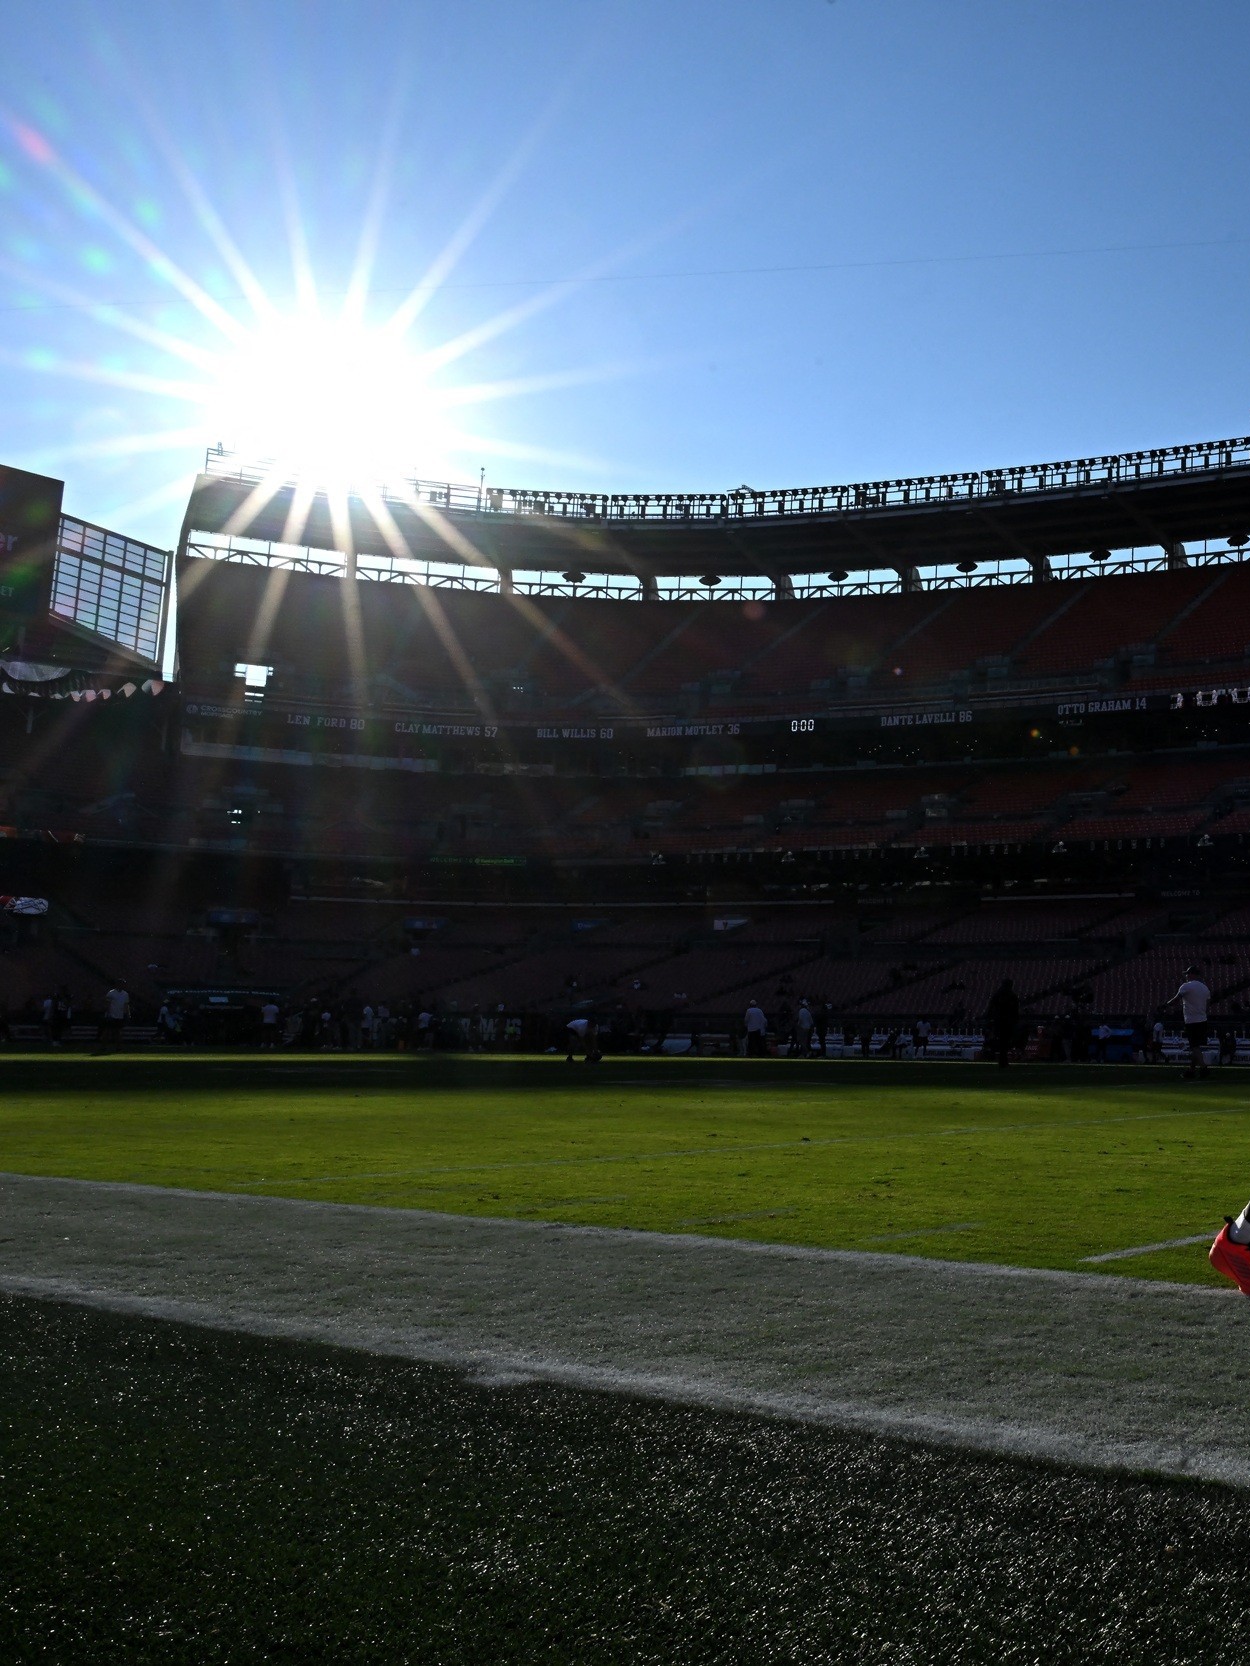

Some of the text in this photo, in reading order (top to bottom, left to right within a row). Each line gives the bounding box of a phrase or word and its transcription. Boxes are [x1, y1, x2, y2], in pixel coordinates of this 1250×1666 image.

[1057, 697, 1147, 715] OTTO GRAHAM 14
[287, 714, 365, 730] LEN FORD 80
[791, 719, 815, 732] 0:00
[881, 710, 973, 727] DANTE LAVELLI 86
[394, 722, 498, 738] CLAY MATTHEWS 57
[537, 728, 613, 739] BILL WILLIS 60
[647, 724, 740, 737] MARION MOTLEY 36
